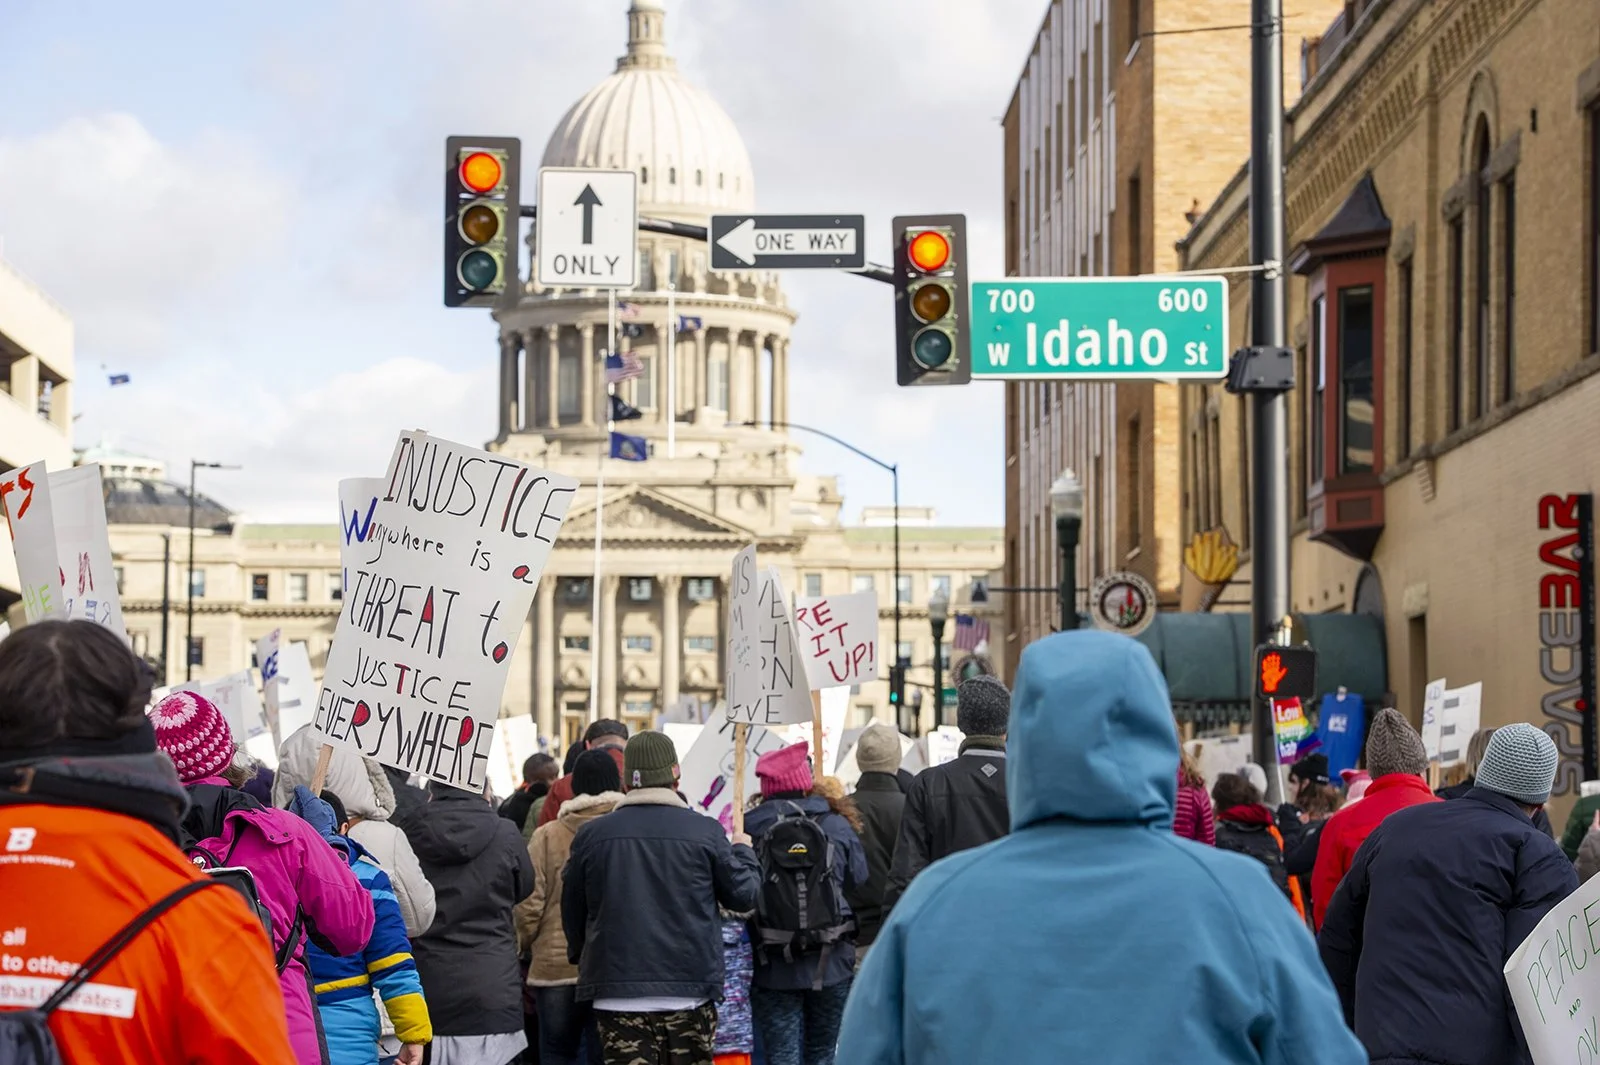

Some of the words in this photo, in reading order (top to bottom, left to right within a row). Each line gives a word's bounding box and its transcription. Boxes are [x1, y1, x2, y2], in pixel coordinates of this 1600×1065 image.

[755, 233, 794, 250] ONE
[808, 233, 848, 250] WAY
[553, 254, 620, 275] ONLY
[986, 289, 1035, 313] 700
[1158, 288, 1208, 312] 600
[987, 342, 1011, 366] W
[1026, 318, 1168, 366] Idaho
[1184, 341, 1209, 366] St
[383, 437, 576, 543] INJUSTICE
[470, 540, 491, 571] is
[512, 565, 533, 584] a
[350, 570, 461, 659] THREAT
[480, 600, 509, 664] to
[811, 622, 849, 658] IT
[342, 647, 472, 711] JUSTICE
[828, 641, 874, 683] UP!
[314, 687, 494, 787] EVERYWHERE
[6, 827, 37, 852] B
[2, 927, 27, 946] all
[2, 953, 24, 973] to
[26, 955, 86, 977] other
[1527, 899, 1600, 1025] PEACE
[1568, 998, 1581, 1020] AND
